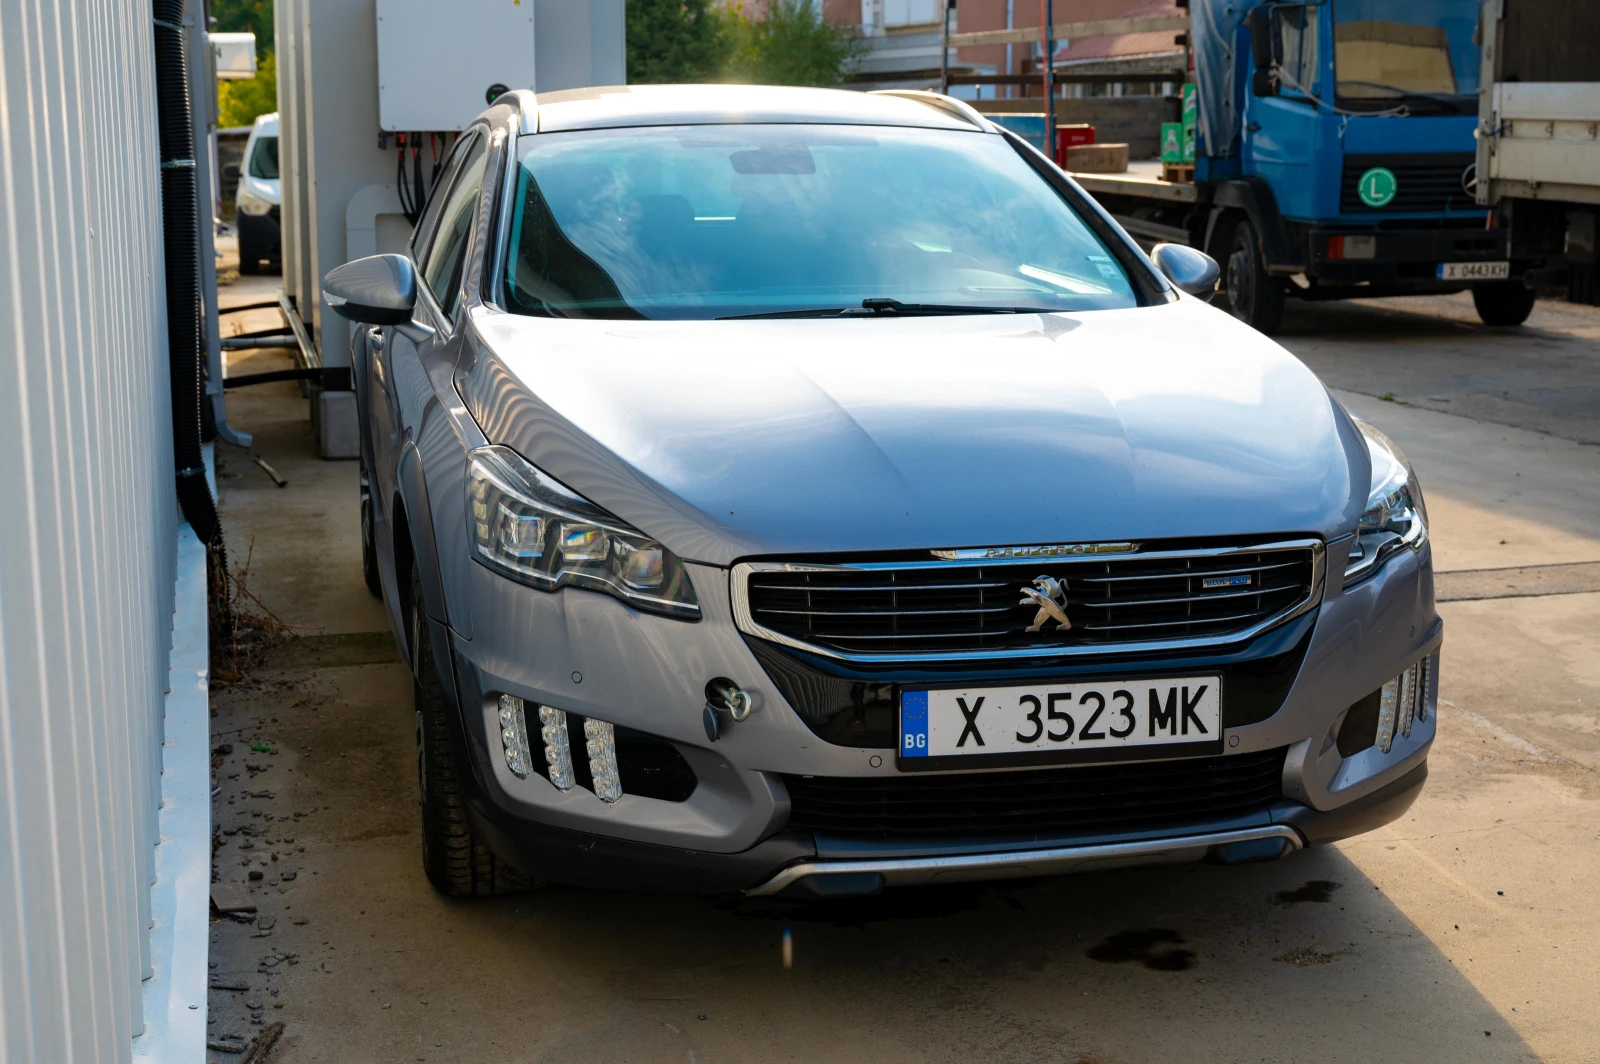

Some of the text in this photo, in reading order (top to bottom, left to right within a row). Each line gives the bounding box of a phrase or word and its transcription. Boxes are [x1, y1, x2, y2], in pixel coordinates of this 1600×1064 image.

[1371, 177, 1384, 199] L
[955, 684, 1209, 748] X 3523 MK
[904, 733, 926, 748] BG
